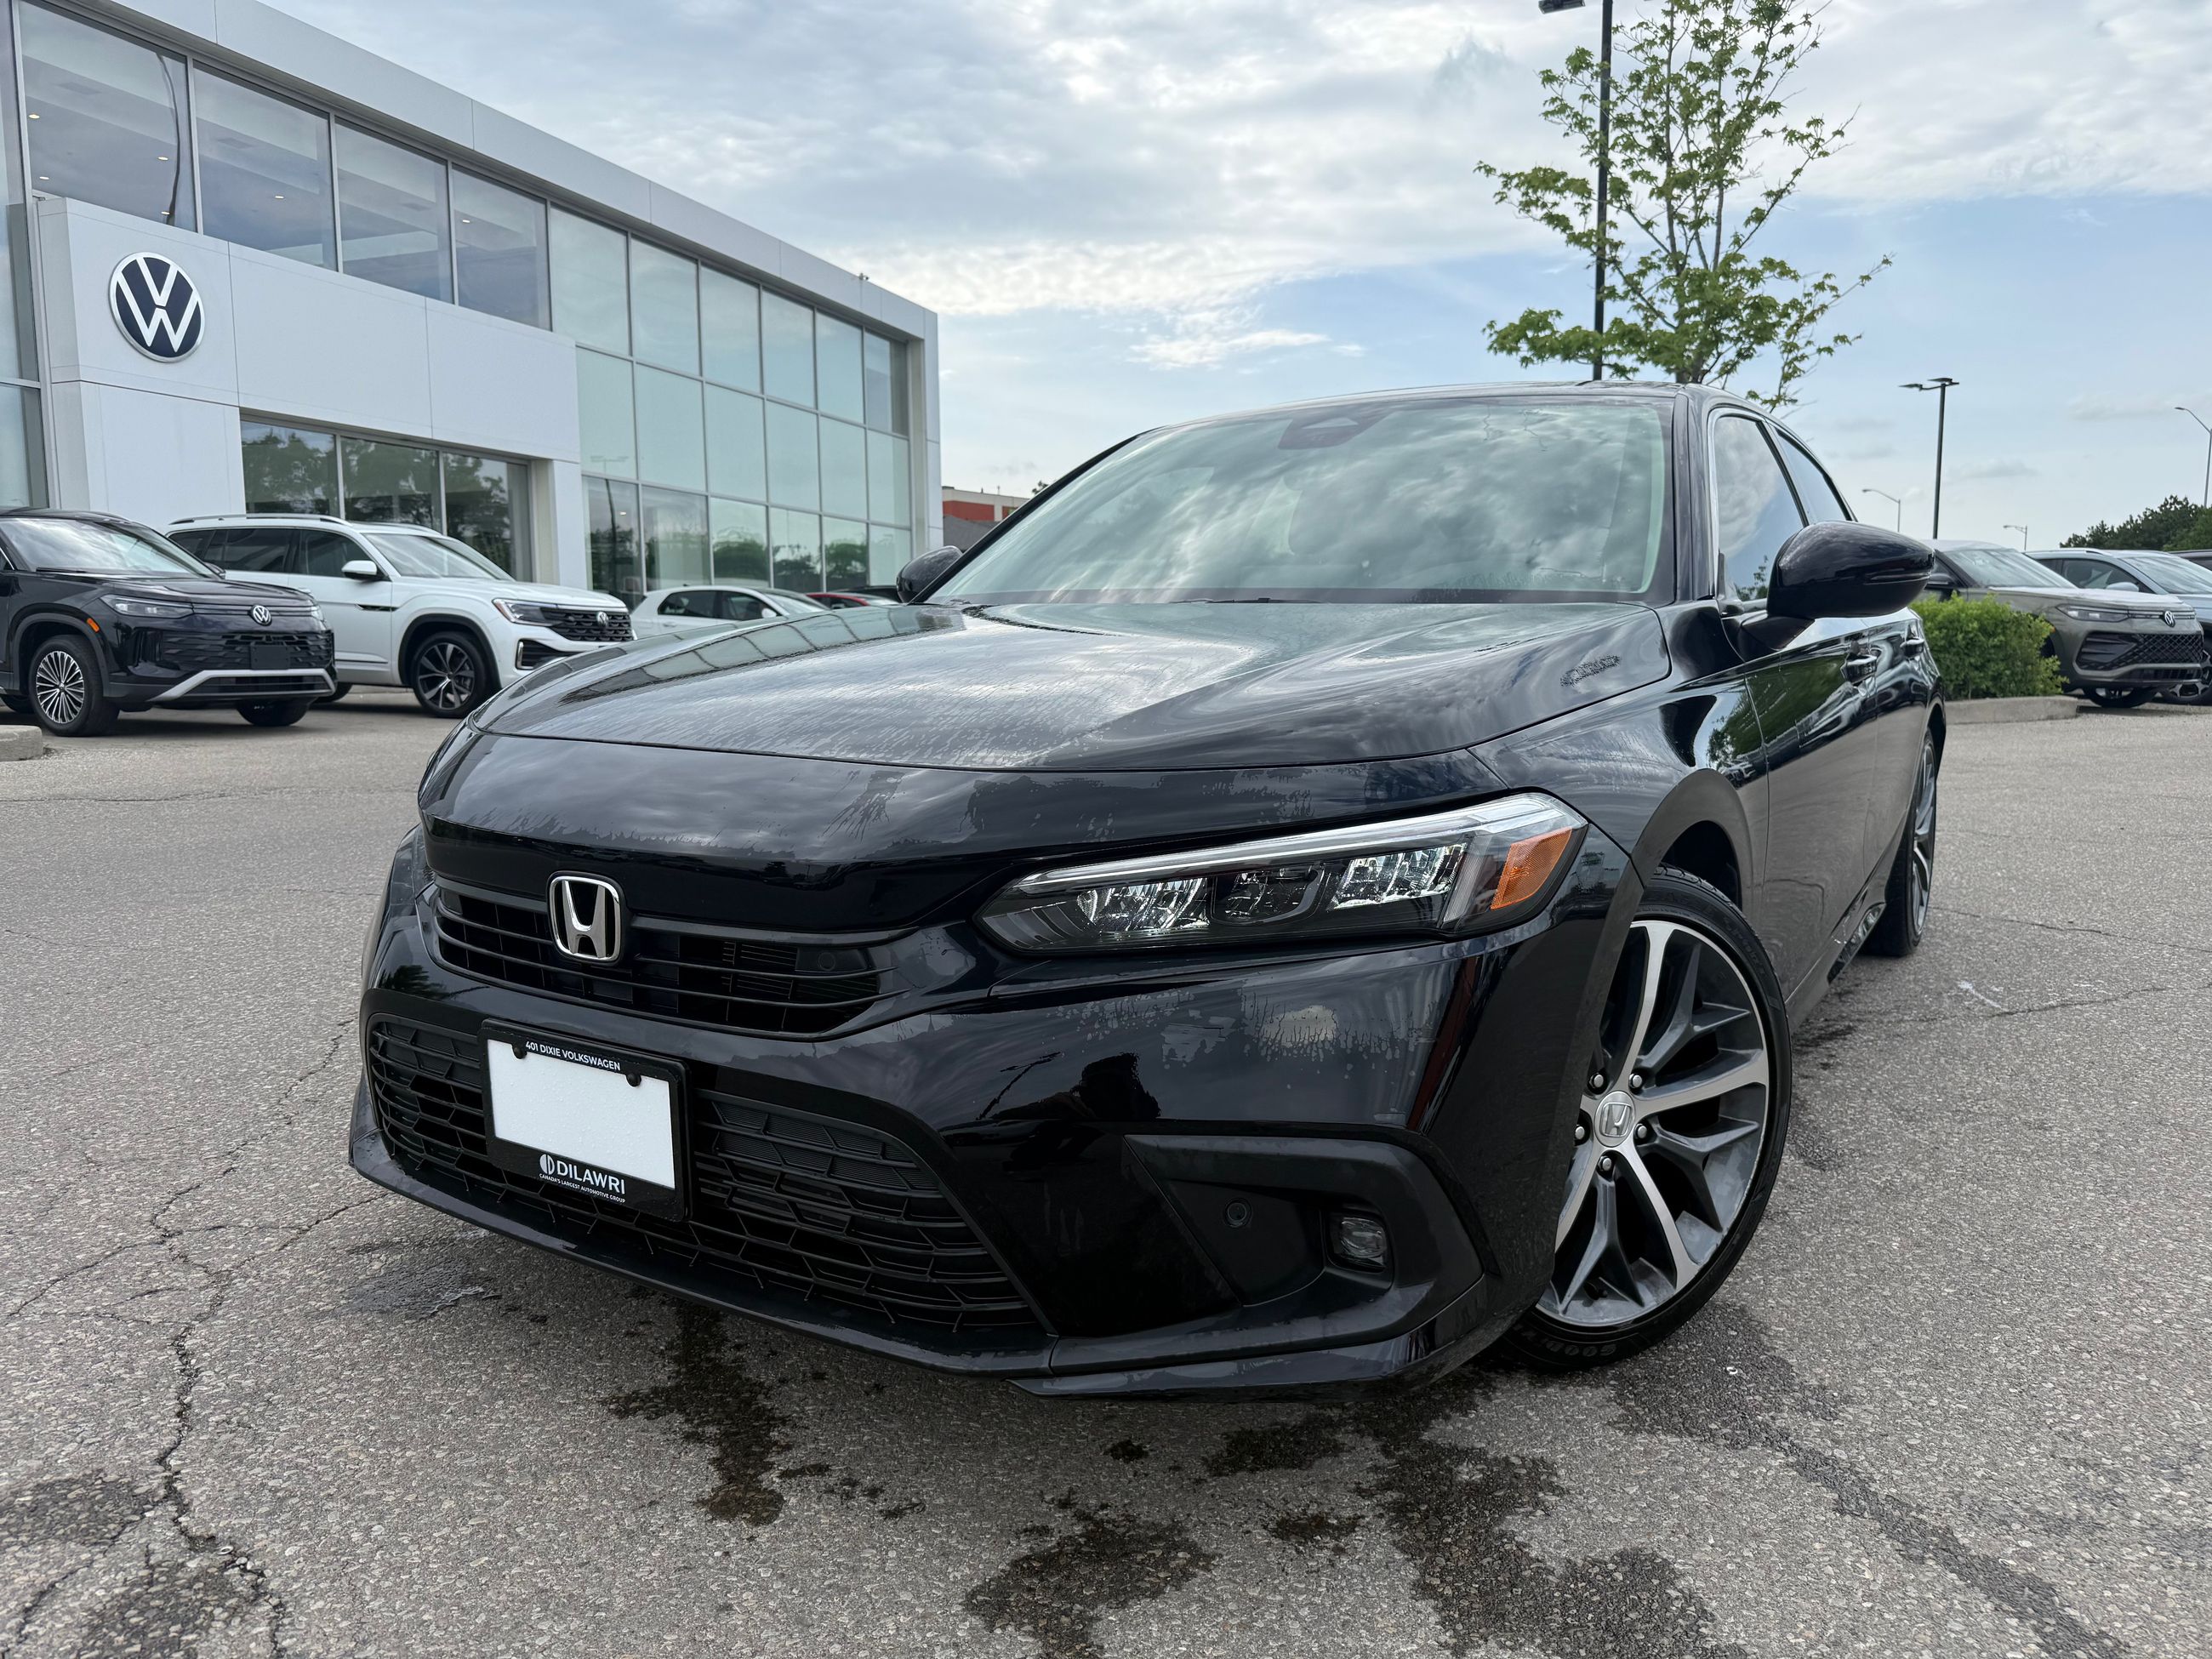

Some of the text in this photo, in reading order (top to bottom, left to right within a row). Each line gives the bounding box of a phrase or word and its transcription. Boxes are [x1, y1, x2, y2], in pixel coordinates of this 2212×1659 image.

[526, 1041, 621, 1071] 401 DIXIE VOLKSWAGEN
[539, 1173, 626, 1203] CANADA'S LARGEST AUTOMOTIVE GROUP
[556, 1160, 626, 1194] DILAWRI
